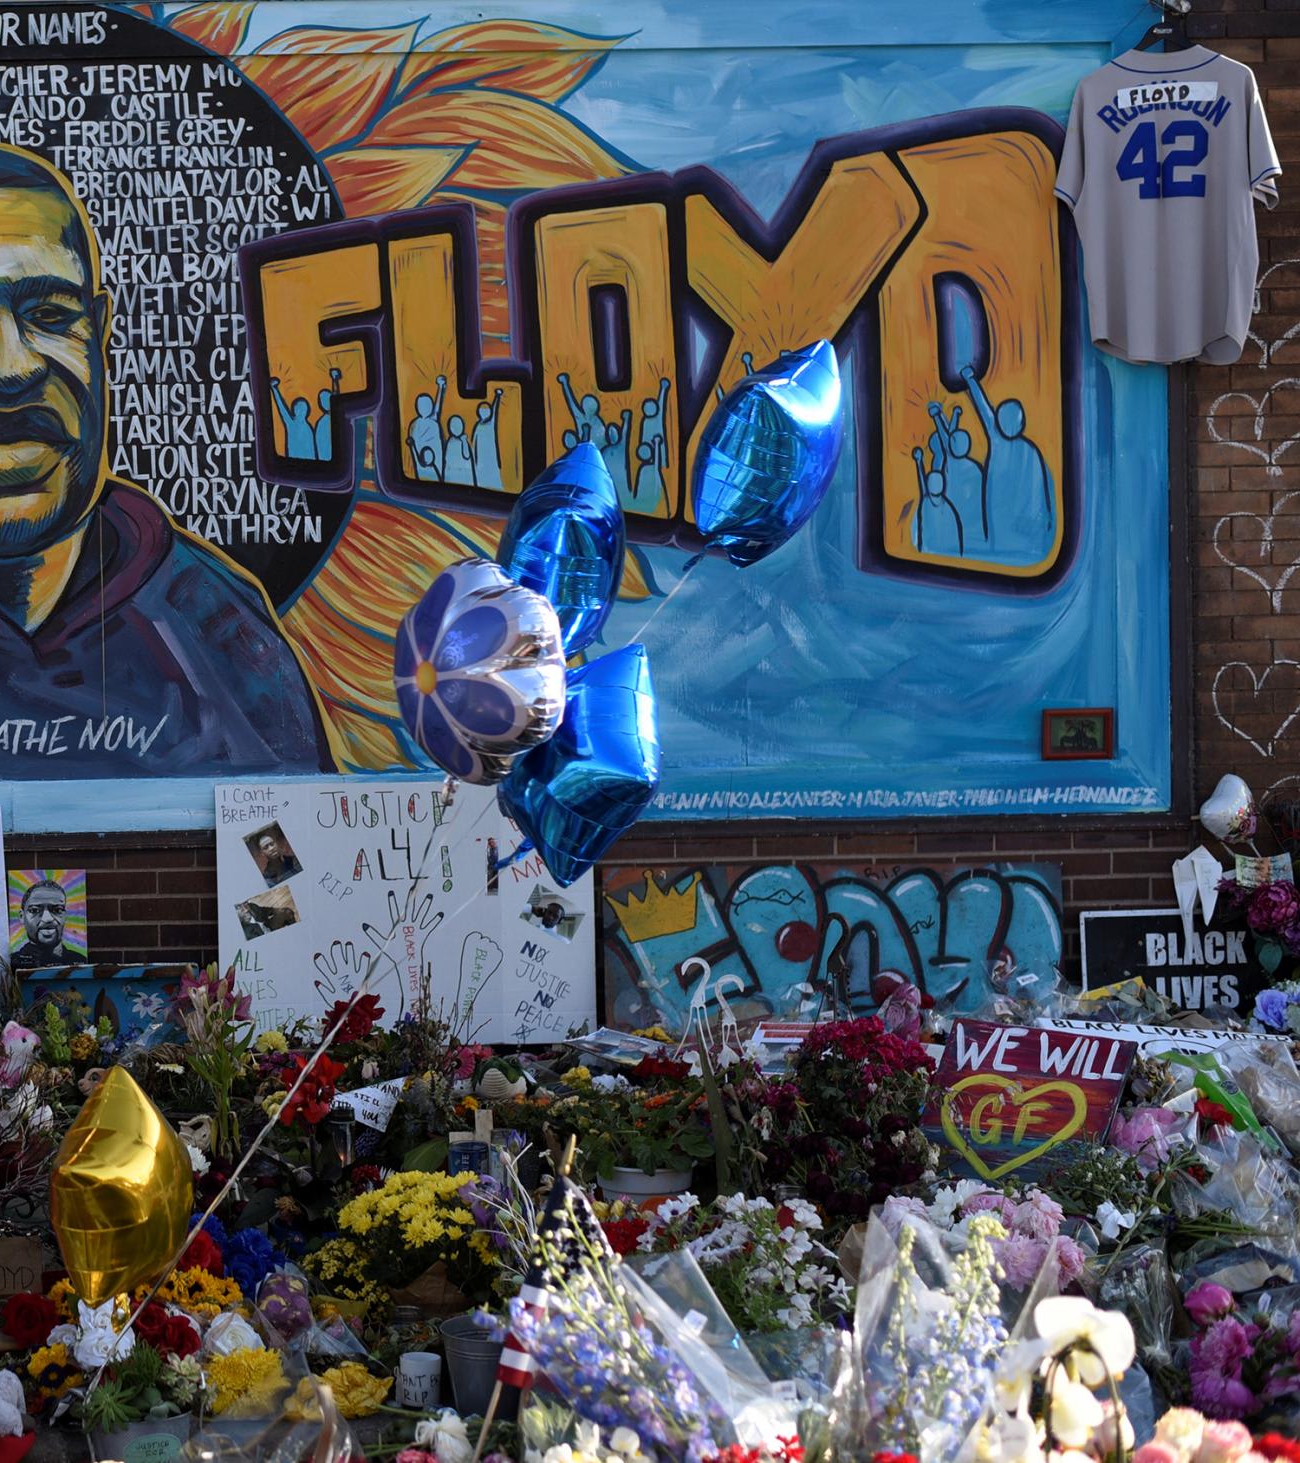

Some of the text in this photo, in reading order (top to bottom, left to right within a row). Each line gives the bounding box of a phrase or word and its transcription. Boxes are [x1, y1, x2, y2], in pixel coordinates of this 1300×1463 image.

[28, 10, 108, 46] NAMES
[80, 64, 191, 97] JEREMY
[1129, 84, 1191, 106] FLOYD
[110, 92, 214, 121] CASTILE
[64, 120, 171, 148] FREDDIE
[176, 117, 247, 146] GREY
[48, 145, 274, 172] TERRANCE FRANKLIN
[1115, 119, 1209, 200] 42
[71, 169, 191, 200] BREONNA
[185, 167, 283, 197] TAYLOR
[87, 197, 203, 228] SHANTEL
[204, 195, 281, 225] DAVIS
[94, 224, 204, 255] WALTER
[100, 254, 179, 286] REKIA
[104, 281, 186, 315] YVETT
[110, 314, 205, 348] SHELLY
[106, 348, 203, 384] JAMAR
[257, 128, 1066, 580] FLOYD
[109, 382, 228, 416] TANISHA
[110, 414, 213, 445] TARIKA
[111, 443, 200, 480] ALTON
[148, 477, 311, 516] KORRYNGA
[186, 514, 323, 546] KATHRYN
[78, 712, 172, 758] NOW
[316, 790, 450, 829] JUSTICE
[232, 948, 264, 972] ALL
[1145, 930, 1249, 967] BLACK
[235, 979, 278, 1001] IVES
[515, 958, 571, 999] JUSTICE
[1155, 974, 1241, 1010] LIVES
[254, 1008, 296, 1030] ATTER
[1051, 1018, 1130, 1033] BLACK
[1136, 1024, 1209, 1040] LIVES
[956, 1022, 1124, 1081] WE WILL
[968, 1095, 1055, 1146] GF
